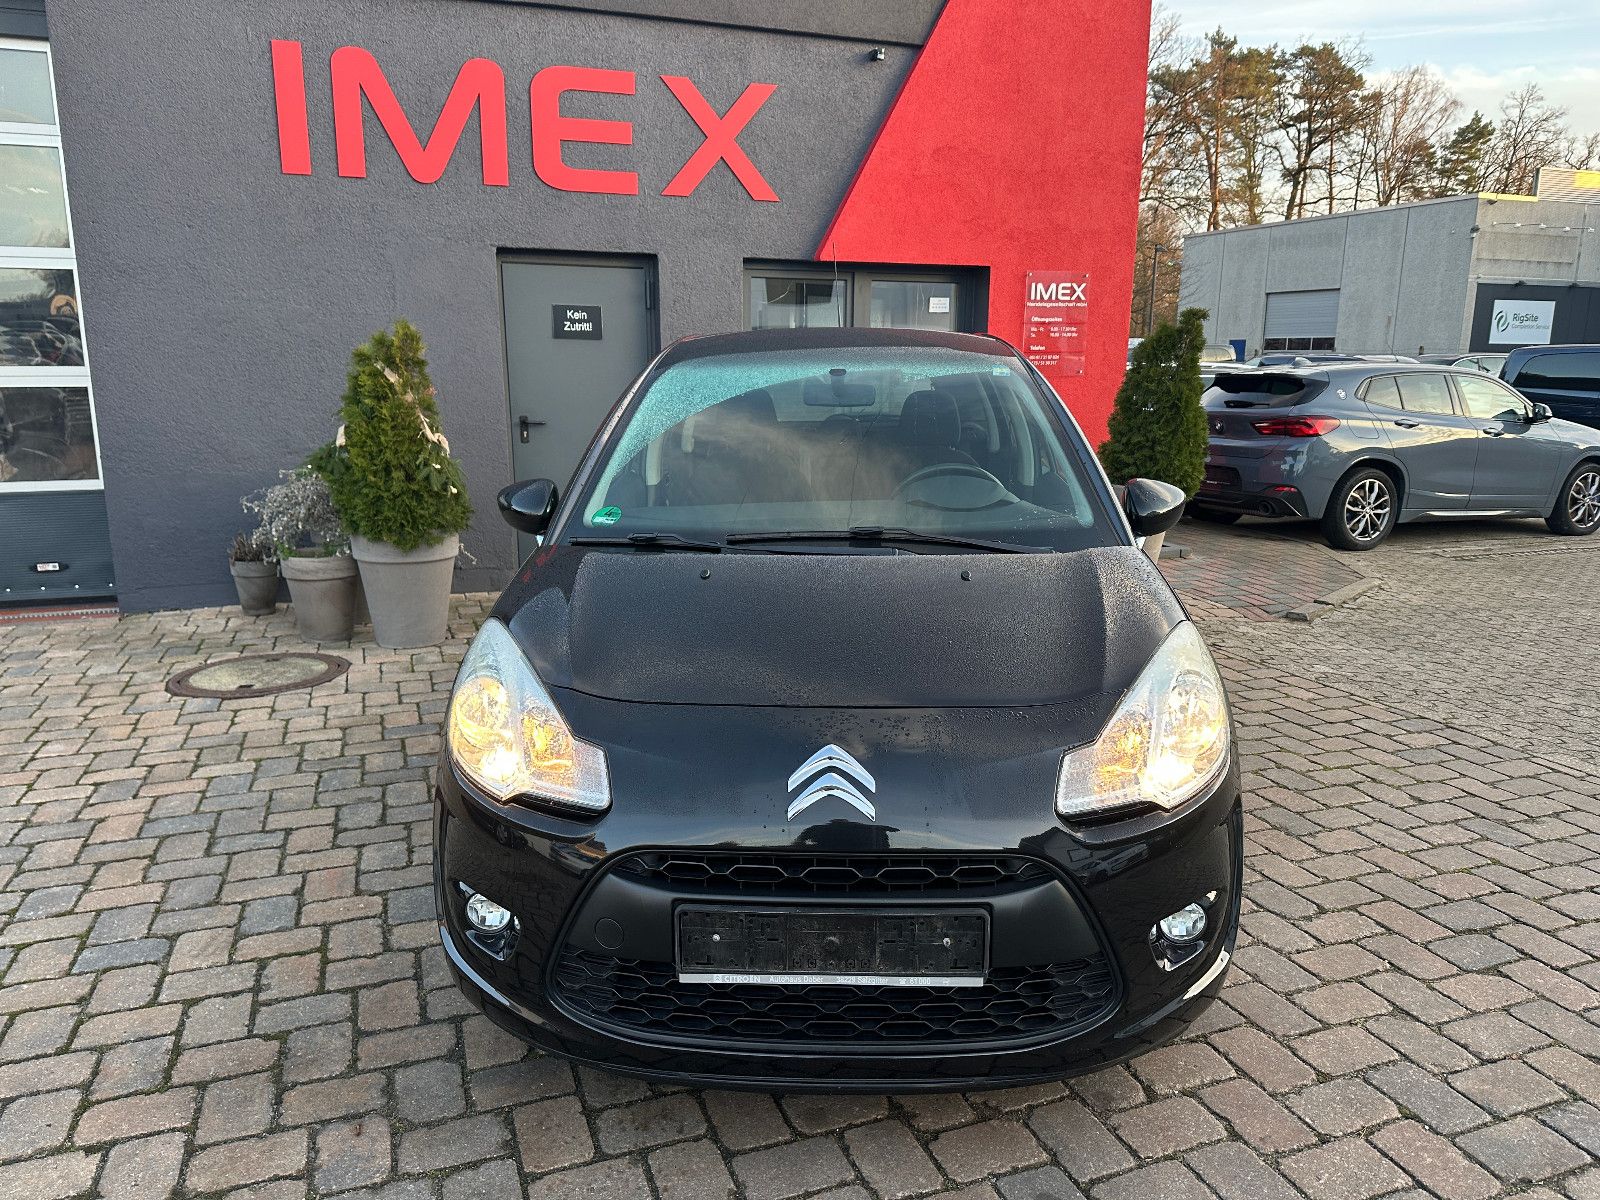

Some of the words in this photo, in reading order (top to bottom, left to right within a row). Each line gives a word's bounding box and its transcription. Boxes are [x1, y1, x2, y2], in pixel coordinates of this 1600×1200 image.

[270, 39, 781, 202] IMEX
[1030, 282, 1087, 301] IMEX
[566, 309, 588, 320] Kein
[1512, 313, 1539, 324] RigSite
[563, 321, 593, 332] Zutritt!
[768, 974, 802, 984] Autohaus
[857, 975, 889, 986] Salzgitter
